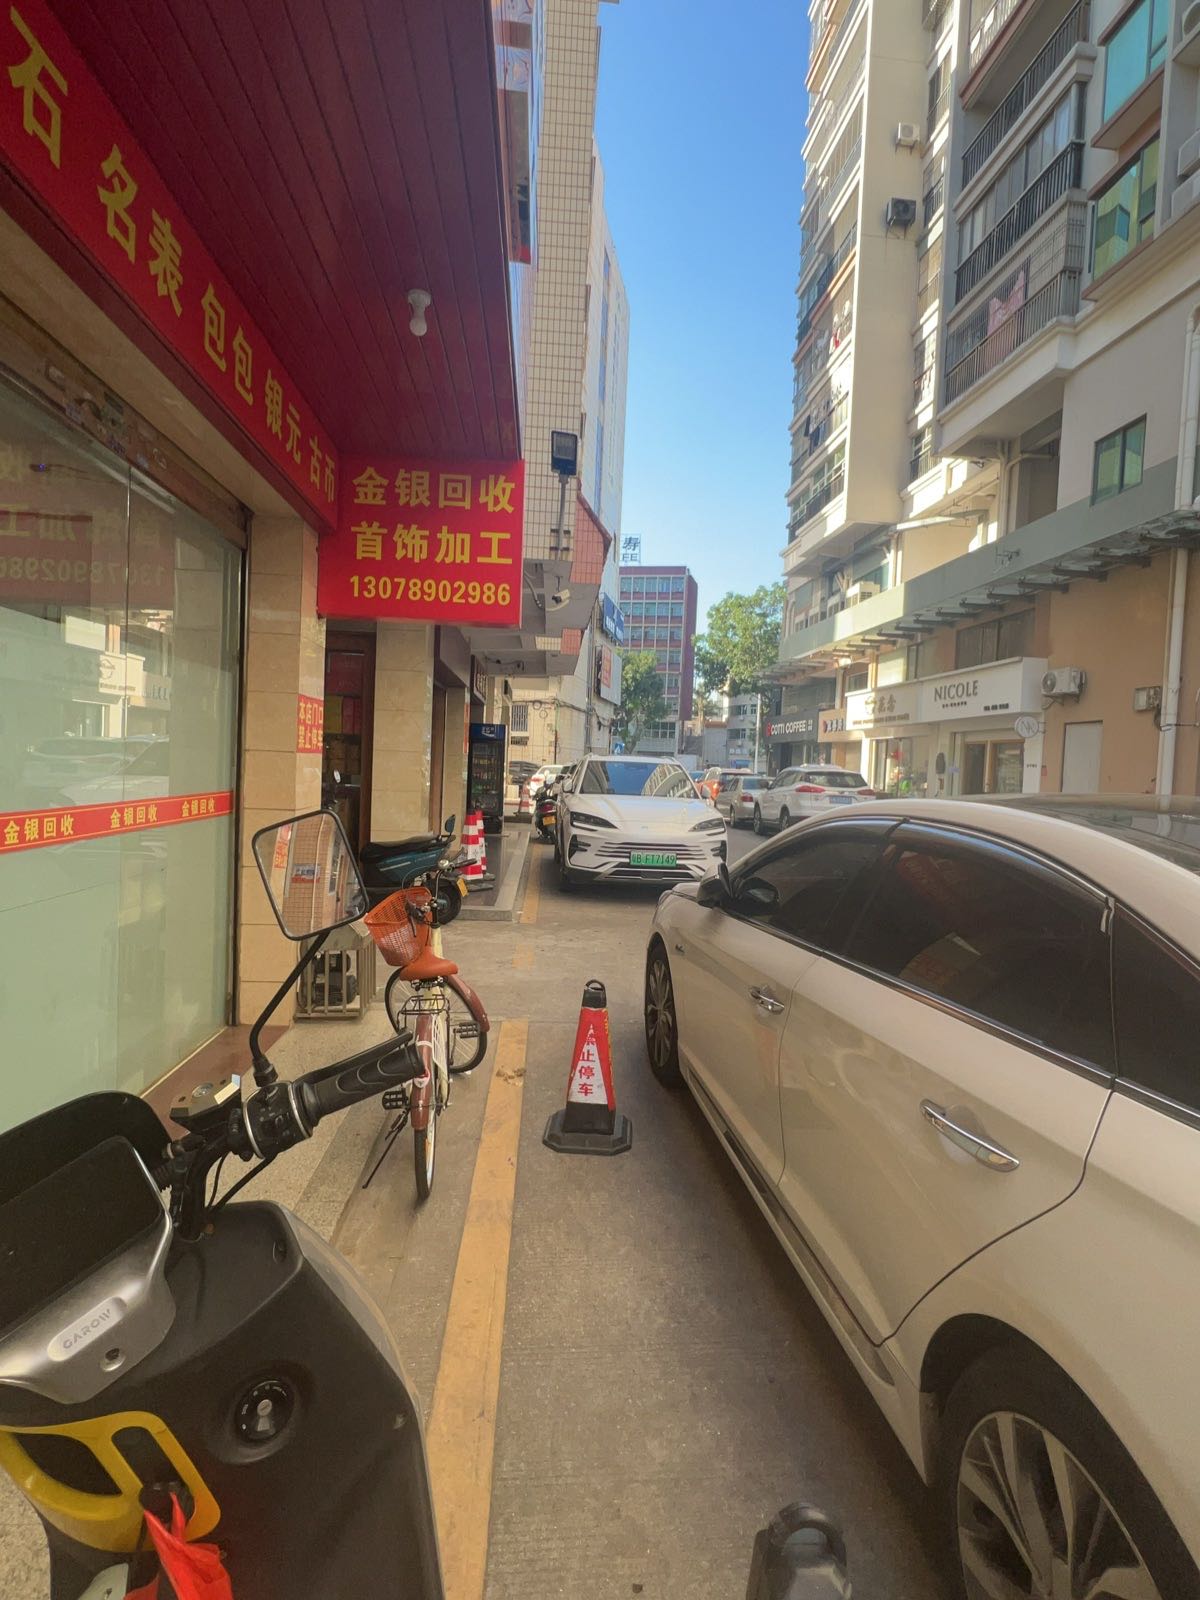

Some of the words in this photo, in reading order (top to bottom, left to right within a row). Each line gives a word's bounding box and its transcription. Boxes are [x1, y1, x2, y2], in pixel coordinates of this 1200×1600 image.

[7, 5, 69, 170] 石
[96, 143, 184, 318] 名表
[200, 282, 255, 407] 包包
[264, 368, 303, 466] 银元
[351, 465, 516, 514] 金银回收
[350, 520, 513, 565] 首饰加工
[349, 575, 511, 606] 13078902986
[933, 679, 979, 702] NICOLE
[299, 701, 324, 725] 本店门口
[770, 722, 786, 736] COTTI
[785, 719, 807, 734] COFFEE
[298, 725, 323, 750] 禁止停车
[3, 813, 75, 845] 金银回收
[110, 803, 158, 829] 金银回收
[181, 797, 216, 818] 金银回收
